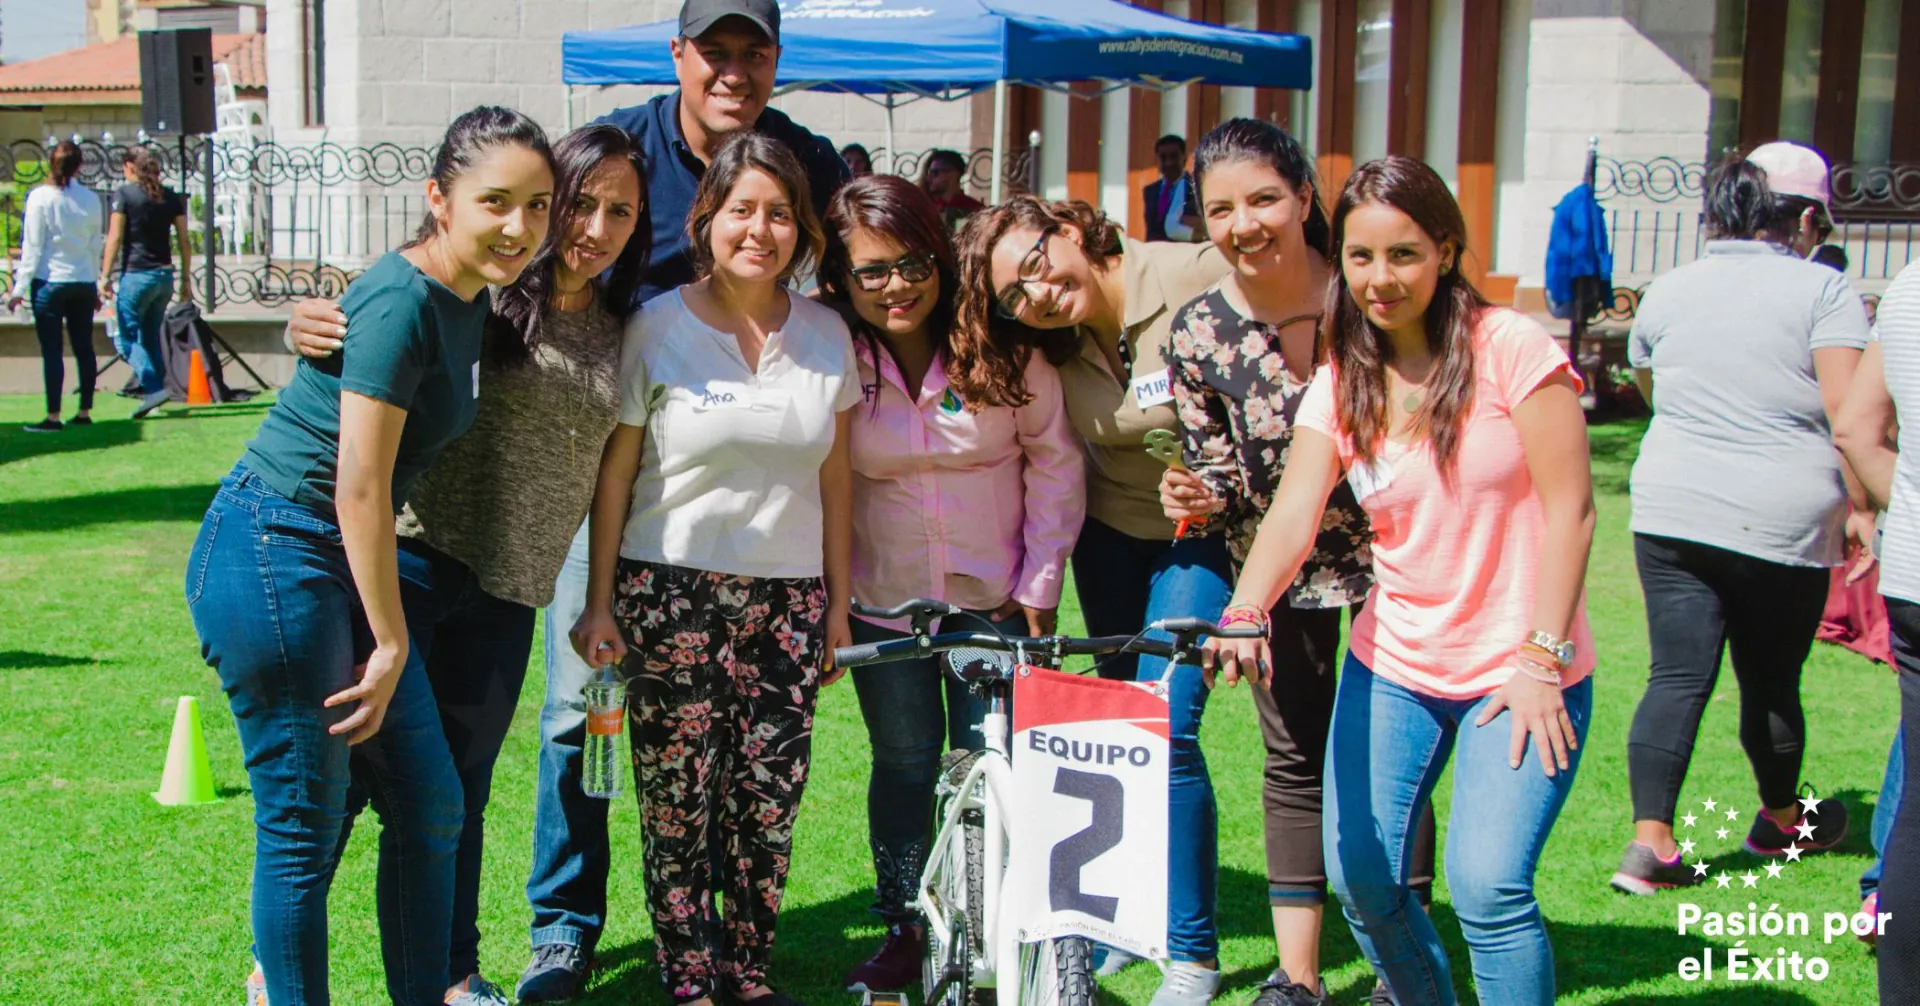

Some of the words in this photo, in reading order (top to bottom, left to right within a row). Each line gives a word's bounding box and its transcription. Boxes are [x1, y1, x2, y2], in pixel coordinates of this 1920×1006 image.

[1099, 37, 1243, 64] www.rallysdeintegracion.com.mx
[702, 388, 737, 407] Ana
[1029, 729, 1151, 767] EQUIPO
[1049, 766, 1124, 923] 2
